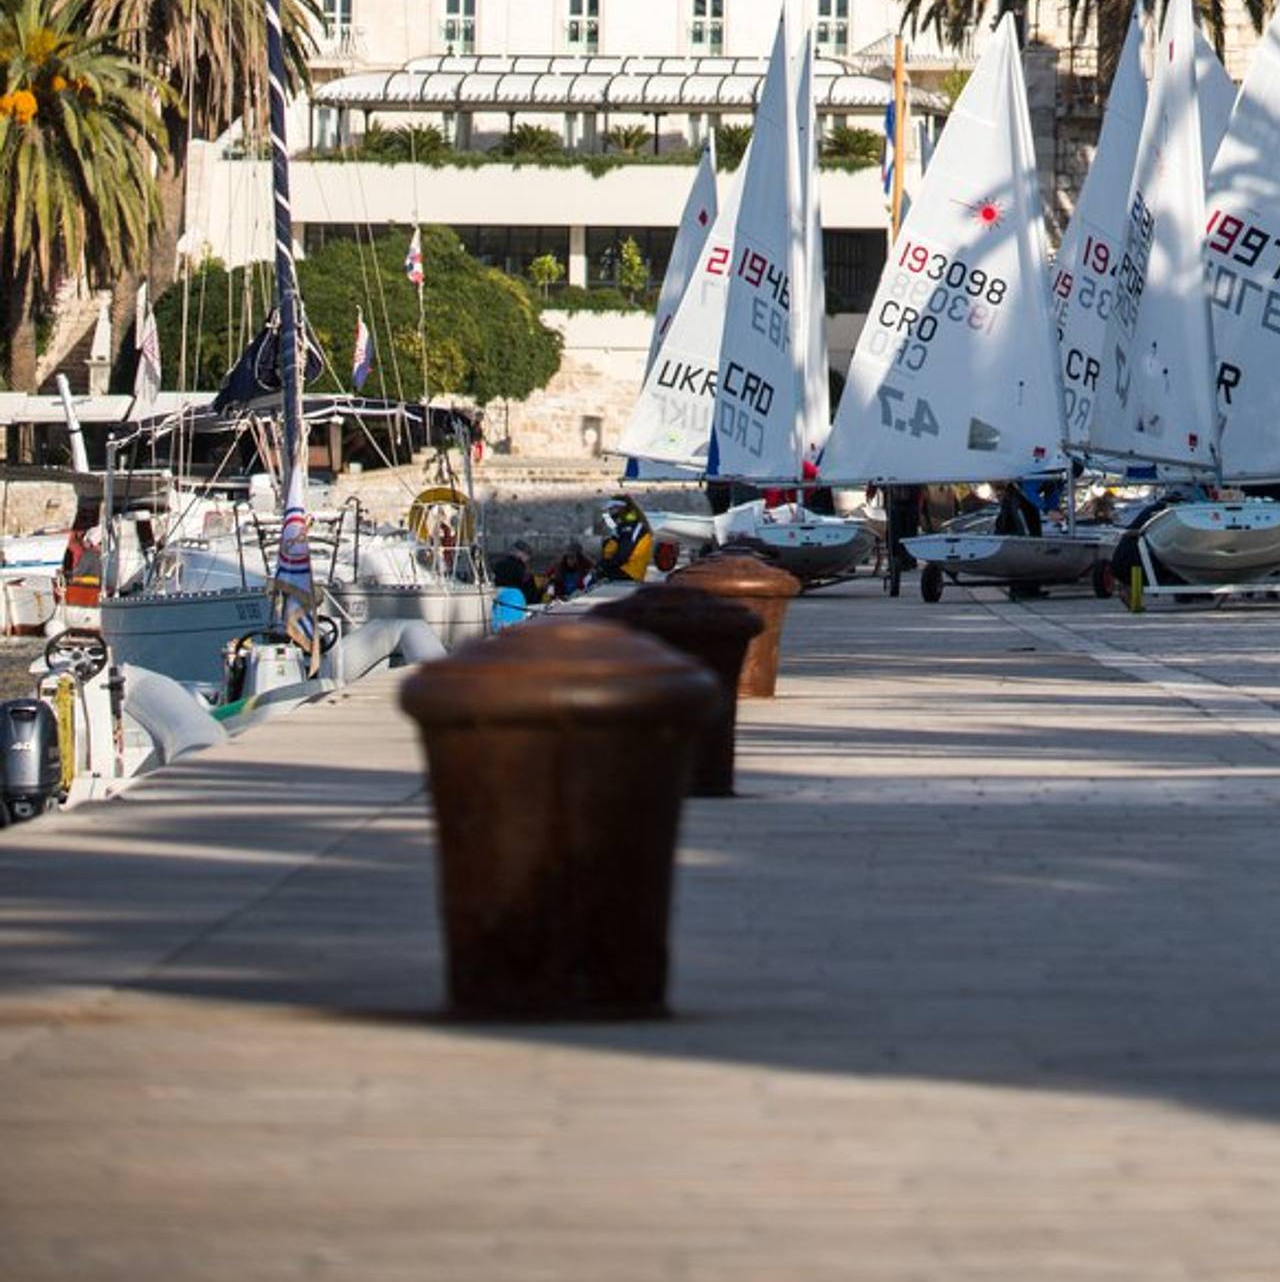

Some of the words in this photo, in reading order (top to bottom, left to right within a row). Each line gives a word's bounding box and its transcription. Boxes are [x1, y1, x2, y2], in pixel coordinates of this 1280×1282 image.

[899, 242, 1006, 305] 193098
[880, 301, 938, 342] CRO
[723, 362, 774, 416] CRO
